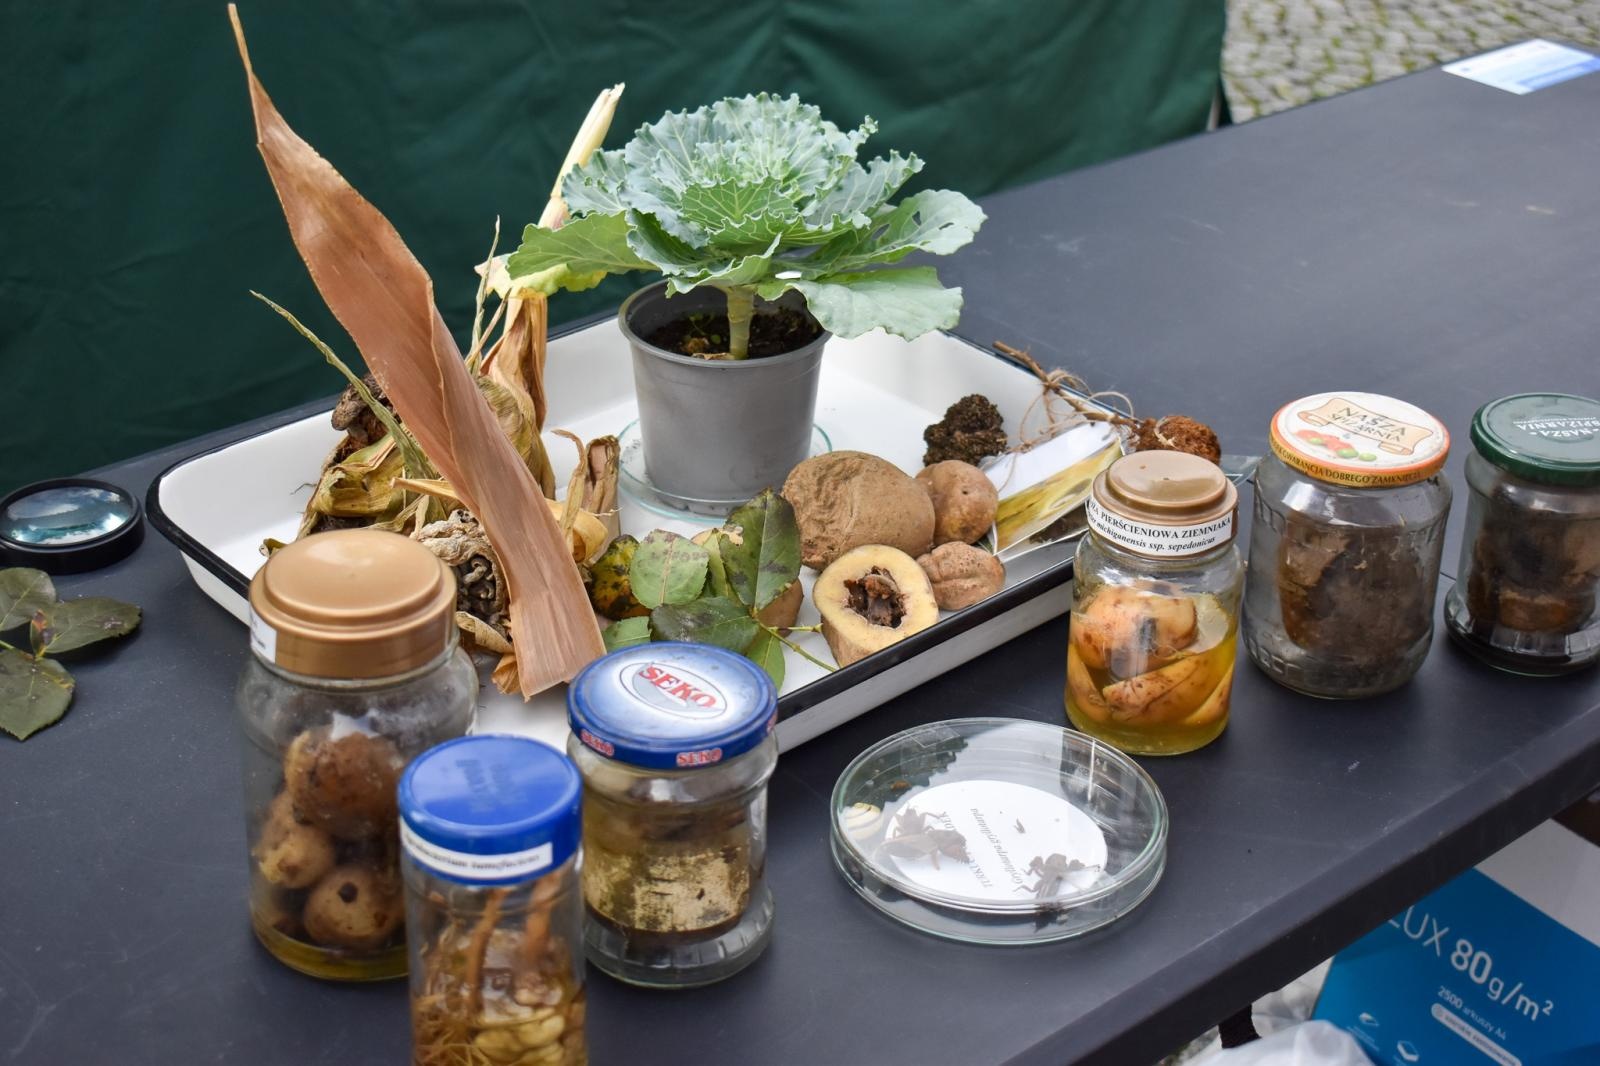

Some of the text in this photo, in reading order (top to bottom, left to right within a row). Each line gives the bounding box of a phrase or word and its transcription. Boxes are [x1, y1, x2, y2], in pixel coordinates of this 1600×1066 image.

[1338, 406, 1407, 437] NASZA
[1540, 428, 1592, 437] NASZA
[1325, 467, 1370, 485] DOBREGO
[1096, 521, 1216, 553] michiganensis ssp. sepedonicus
[1100, 510, 1179, 540] PIERŚCIENIOWA
[1181, 515, 1231, 539] ZIEMNIAKA
[639, 665, 716, 709] SEKO
[676, 748, 722, 767] SEKO
[1388, 904, 1450, 958] UX
[1437, 985, 1464, 1010] 2500
[1462, 1005, 1495, 1033] arkuszy
